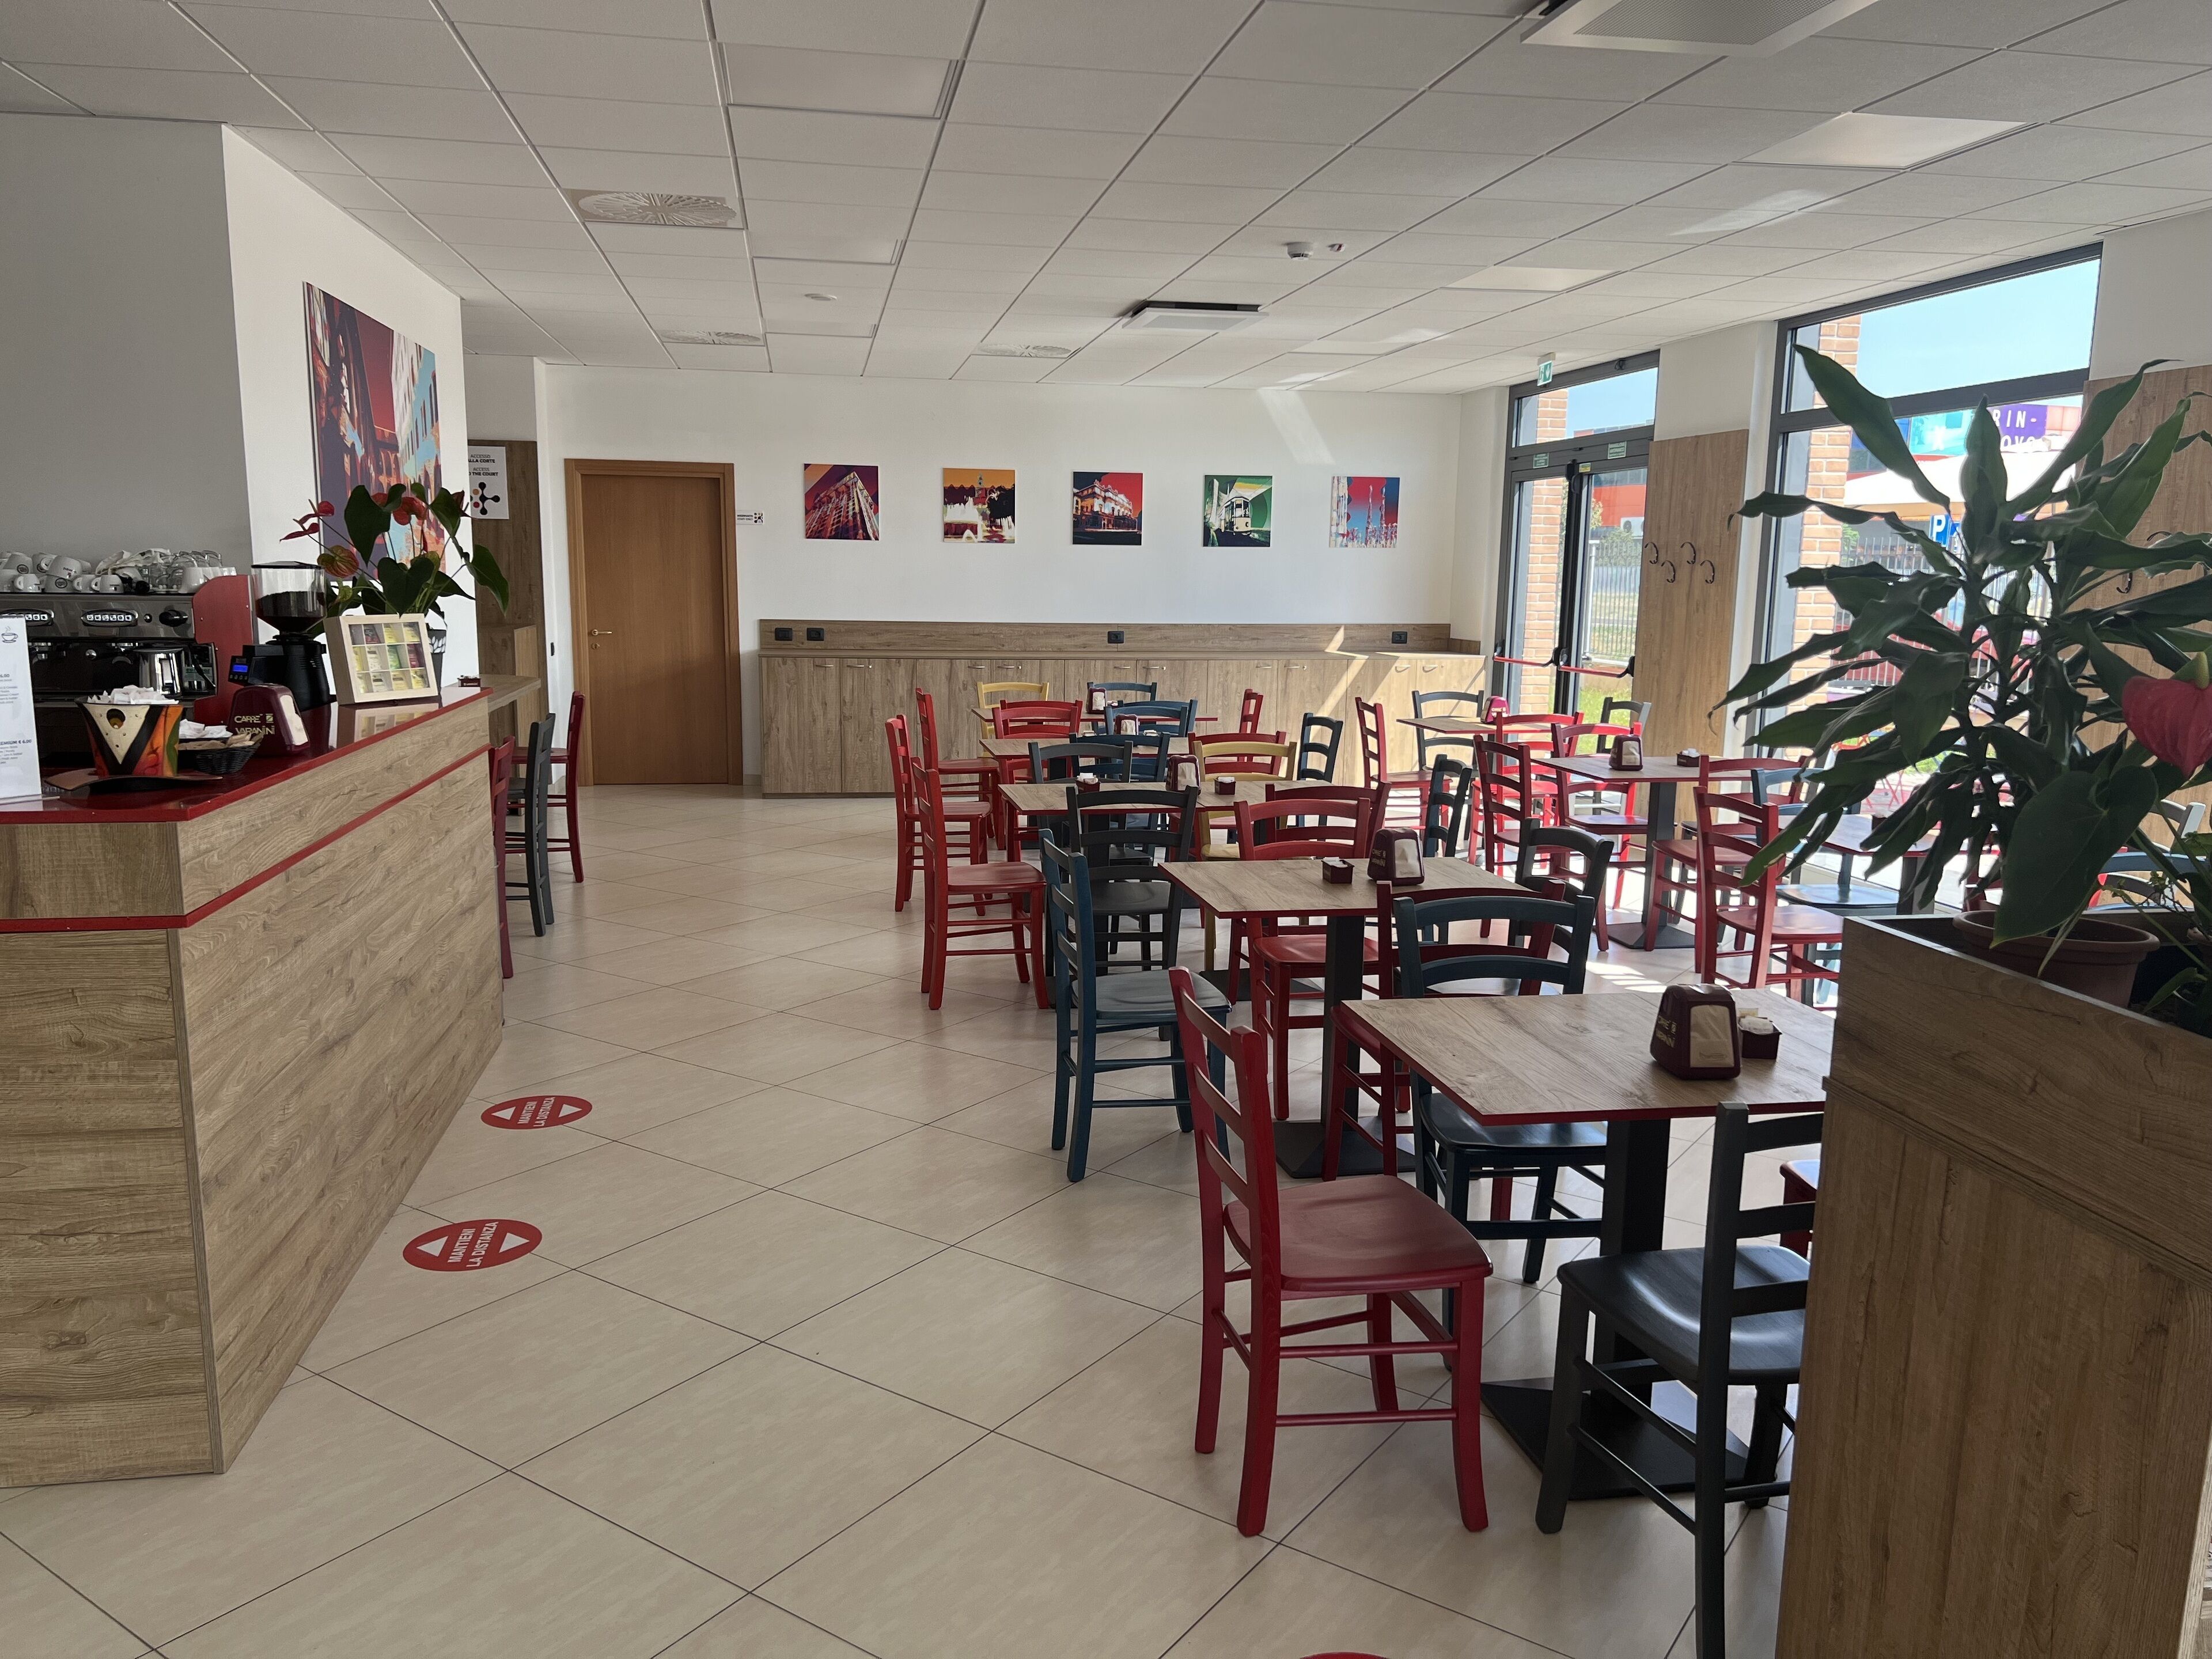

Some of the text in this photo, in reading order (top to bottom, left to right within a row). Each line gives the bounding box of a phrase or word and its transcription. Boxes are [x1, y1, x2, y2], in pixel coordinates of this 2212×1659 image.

[1933, 515, 1946, 542] P
[517, 1101, 538, 1125] MANTIENI
[536, 1096, 556, 1122] DISTANZA
[448, 1228, 476, 1263] MANTIENI
[465, 1221, 499, 1267] LA DISTANZA
